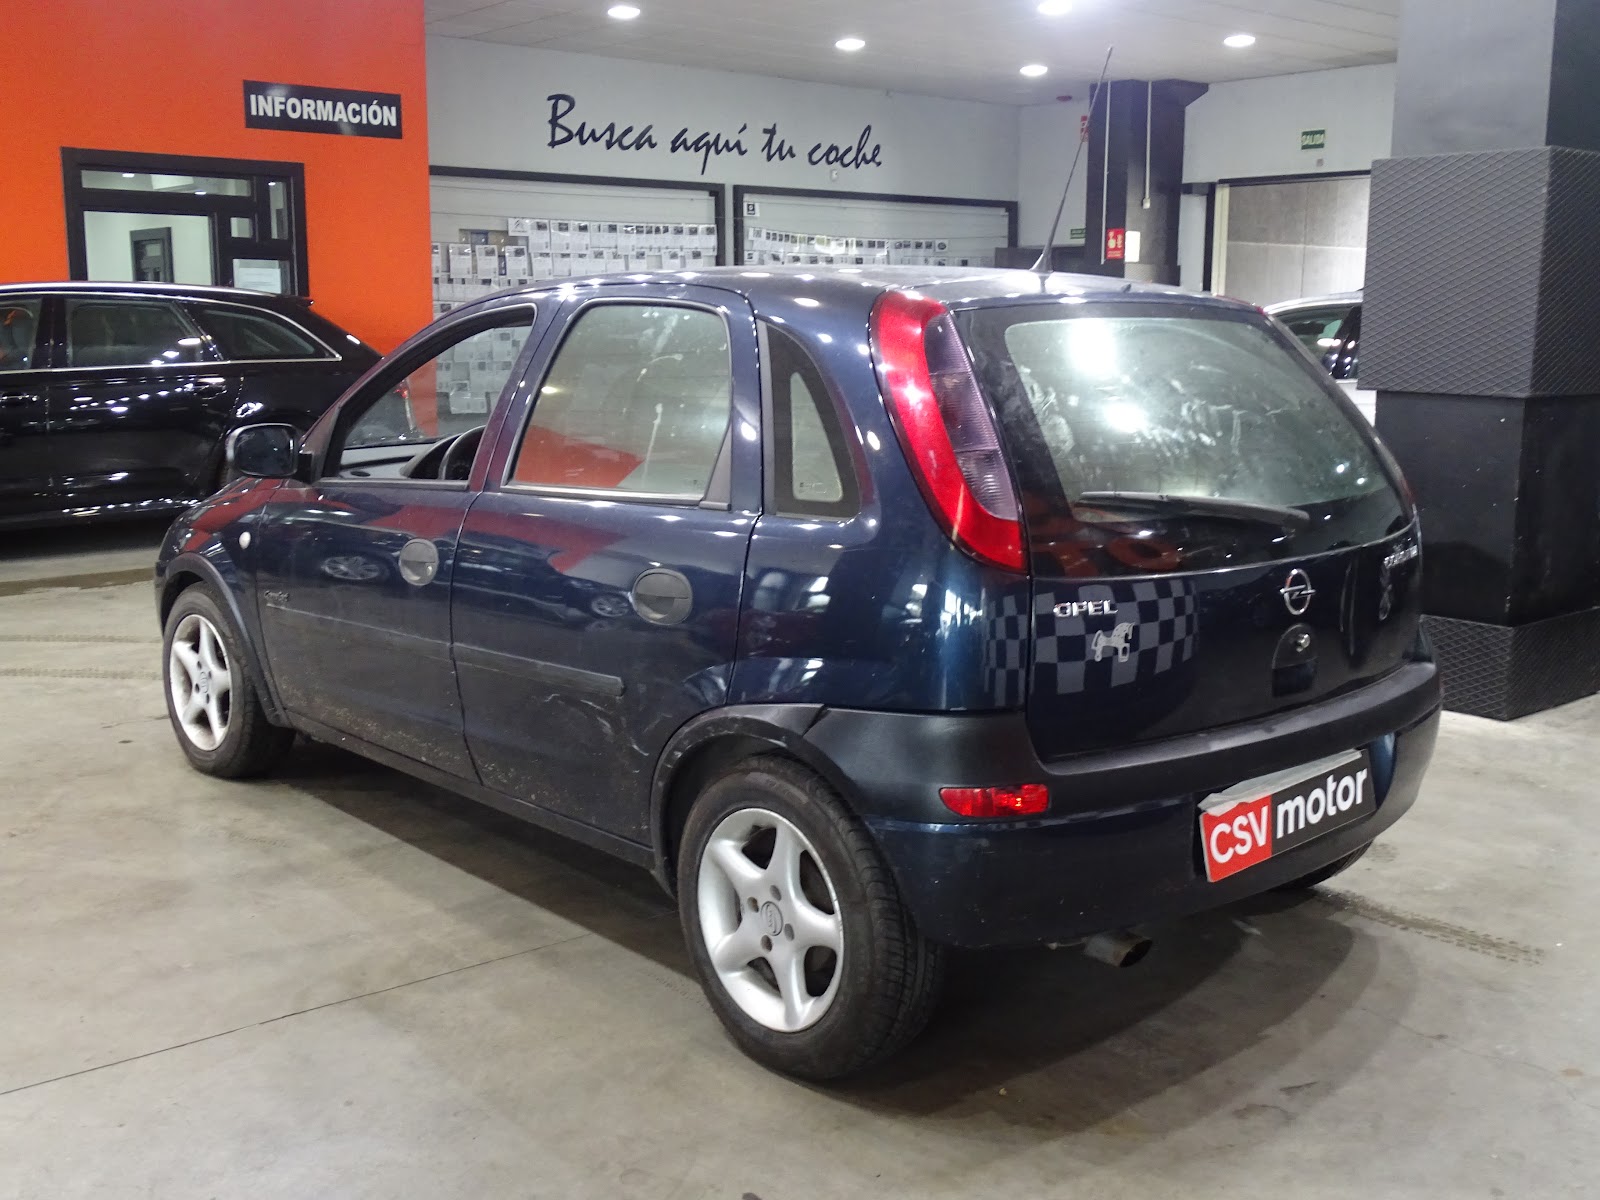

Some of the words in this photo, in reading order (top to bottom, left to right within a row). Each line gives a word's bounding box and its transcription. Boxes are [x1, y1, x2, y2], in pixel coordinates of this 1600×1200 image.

[249, 94, 397, 127] INFORMACIÓN
[546, 93, 658, 151] Busca
[670, 122, 748, 175] aquí
[760, 122, 796, 162] tu
[807, 124, 882, 169] coche
[1052, 599, 1119, 617] OPEL
[1209, 805, 1270, 864] CSV
[1276, 767, 1368, 839] motor
